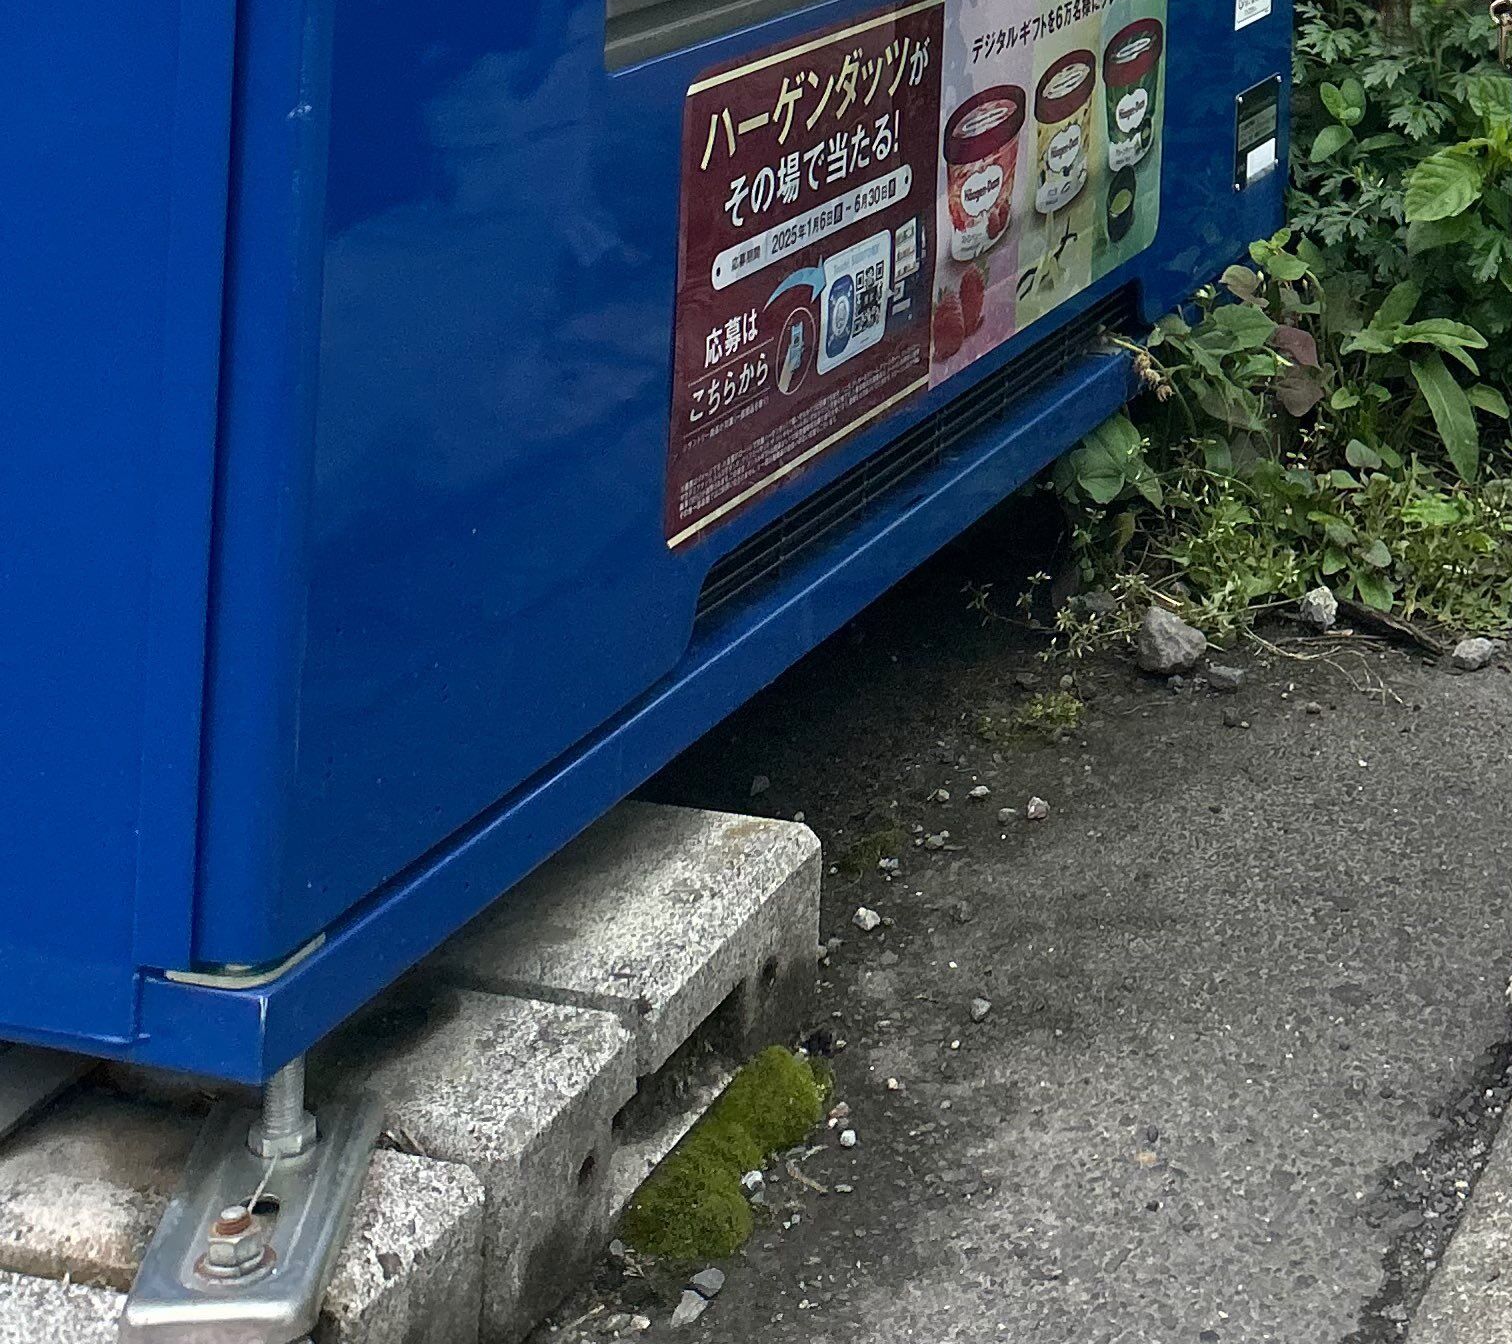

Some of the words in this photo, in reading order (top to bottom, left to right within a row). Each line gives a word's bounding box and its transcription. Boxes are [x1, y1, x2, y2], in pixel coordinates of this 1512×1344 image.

[700, 36, 931, 171] ハーゲンダッツが
[724, 109, 901, 228] その場で当たる!
[704, 307, 758, 369] 応募は
[689, 352, 769, 423] こちらから
